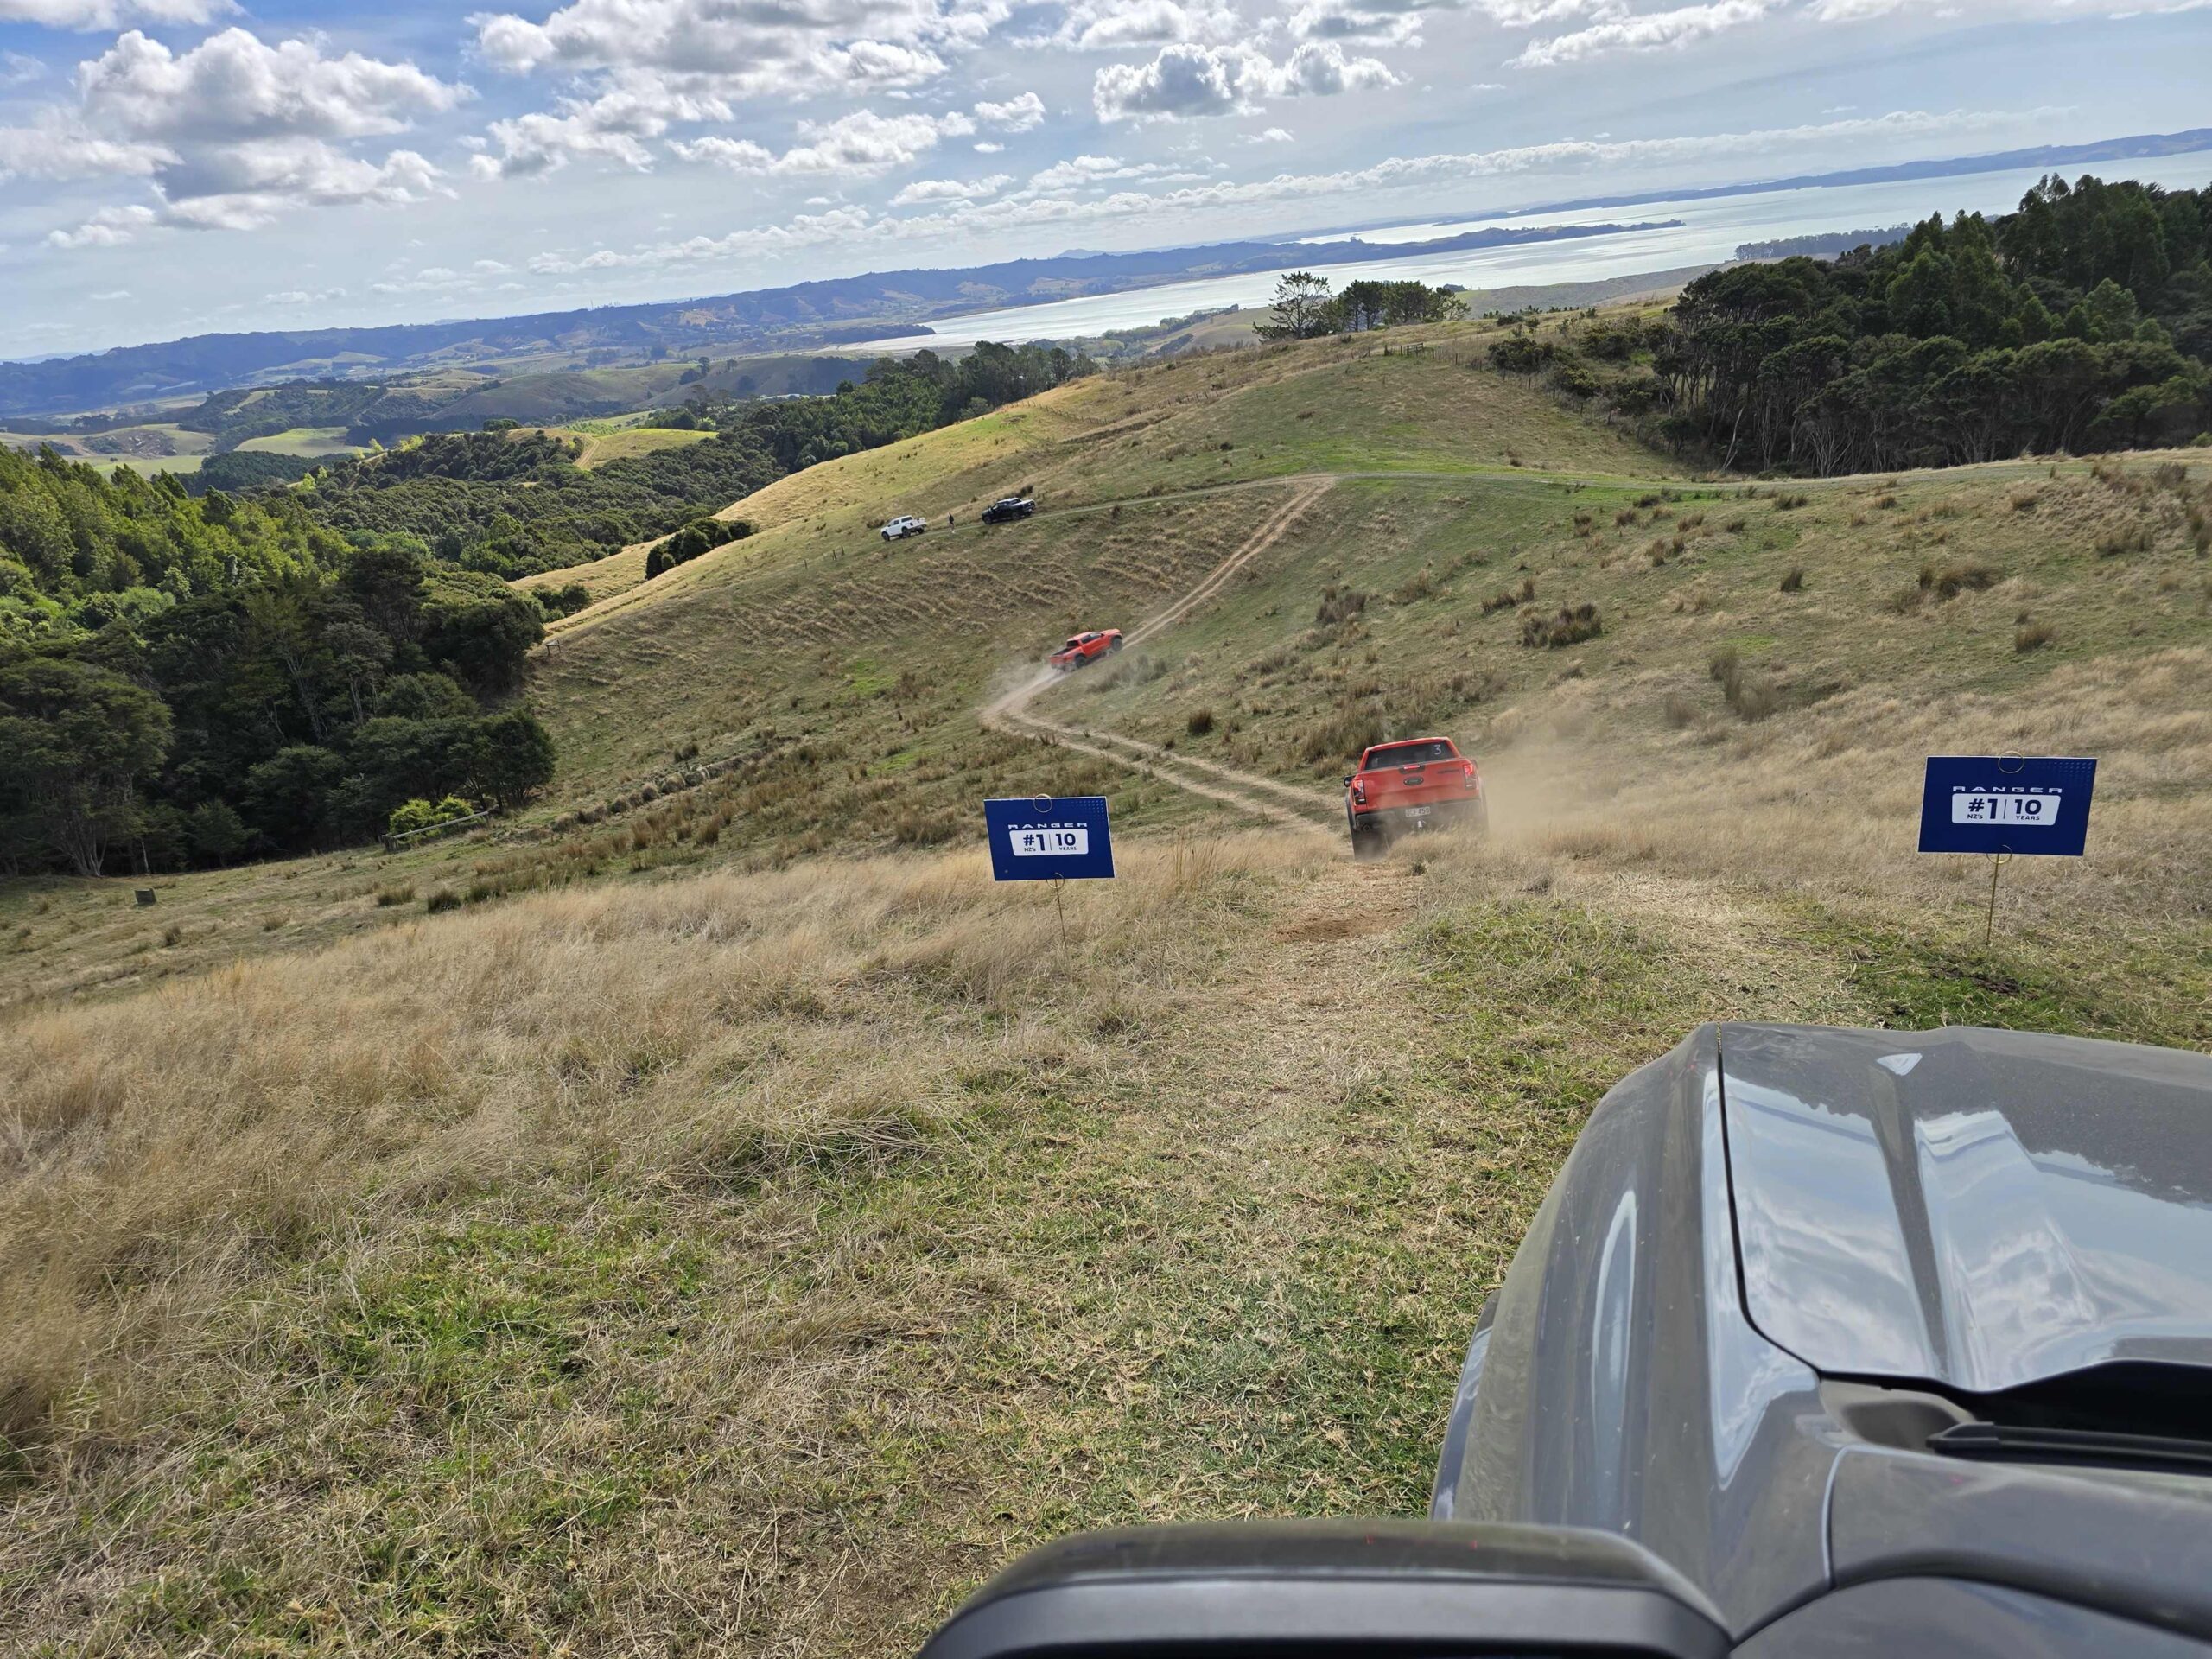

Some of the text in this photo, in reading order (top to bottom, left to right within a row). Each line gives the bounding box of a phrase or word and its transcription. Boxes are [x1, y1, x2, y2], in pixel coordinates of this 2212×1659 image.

[1434, 744, 1441, 755] 3
[1968, 798, 2042, 820] #1 10
[1023, 833, 1076, 851] #1 10
